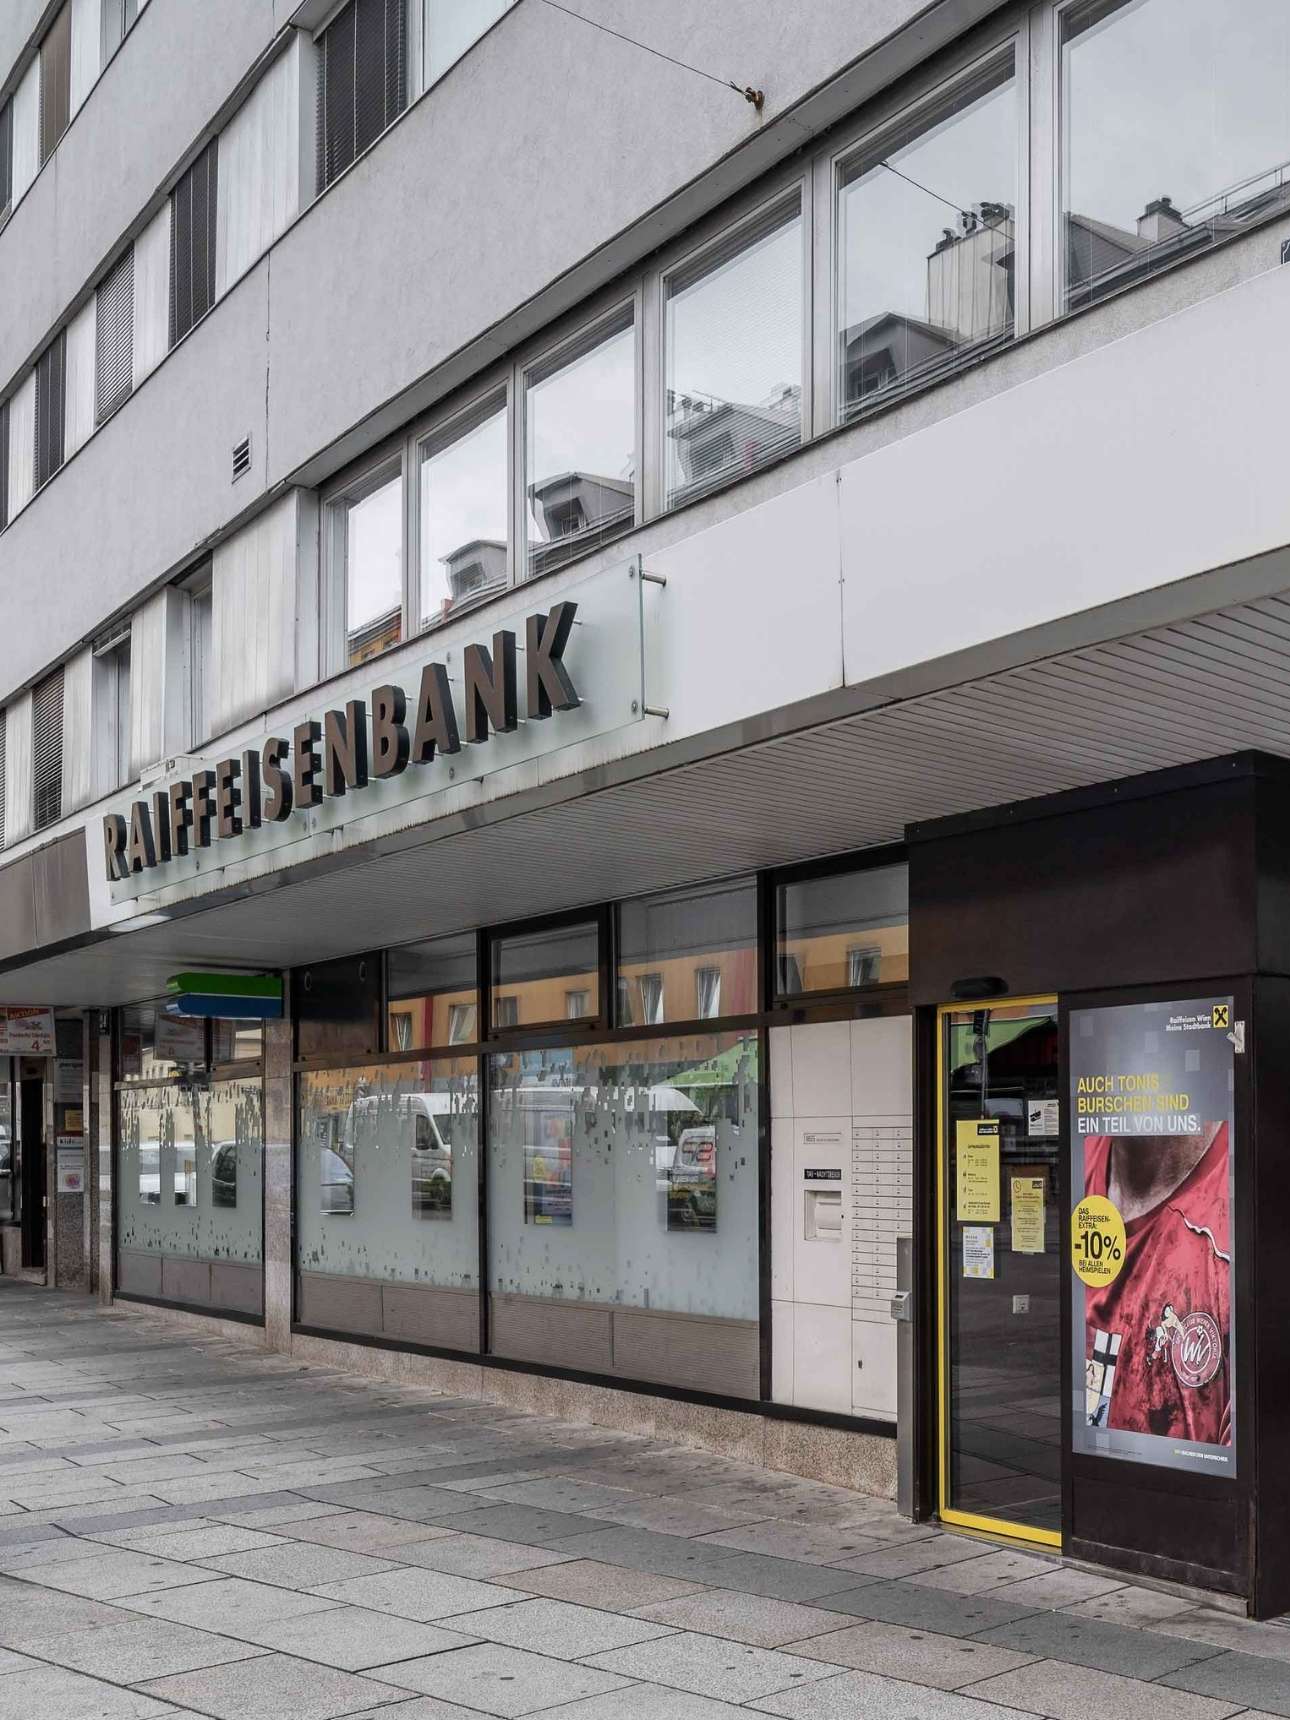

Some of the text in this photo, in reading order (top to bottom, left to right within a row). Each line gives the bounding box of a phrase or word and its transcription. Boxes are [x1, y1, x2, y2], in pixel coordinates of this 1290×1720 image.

[103, 601, 583, 882] RAIFFEISENBANK
[1077, 1074, 1159, 1093] AUCH TONIS
[1077, 1095, 1190, 1113] BURSCHEN SIND
[1078, 1117, 1099, 1134] EIN
[1102, 1117, 1131, 1133] TEIL
[1135, 1116, 1164, 1133] VON
[1167, 1115, 1201, 1132] UNS.
[1074, 1231, 1121, 1260] -10%
[1079, 1267, 1111, 1275] HEIMSPIELEN
